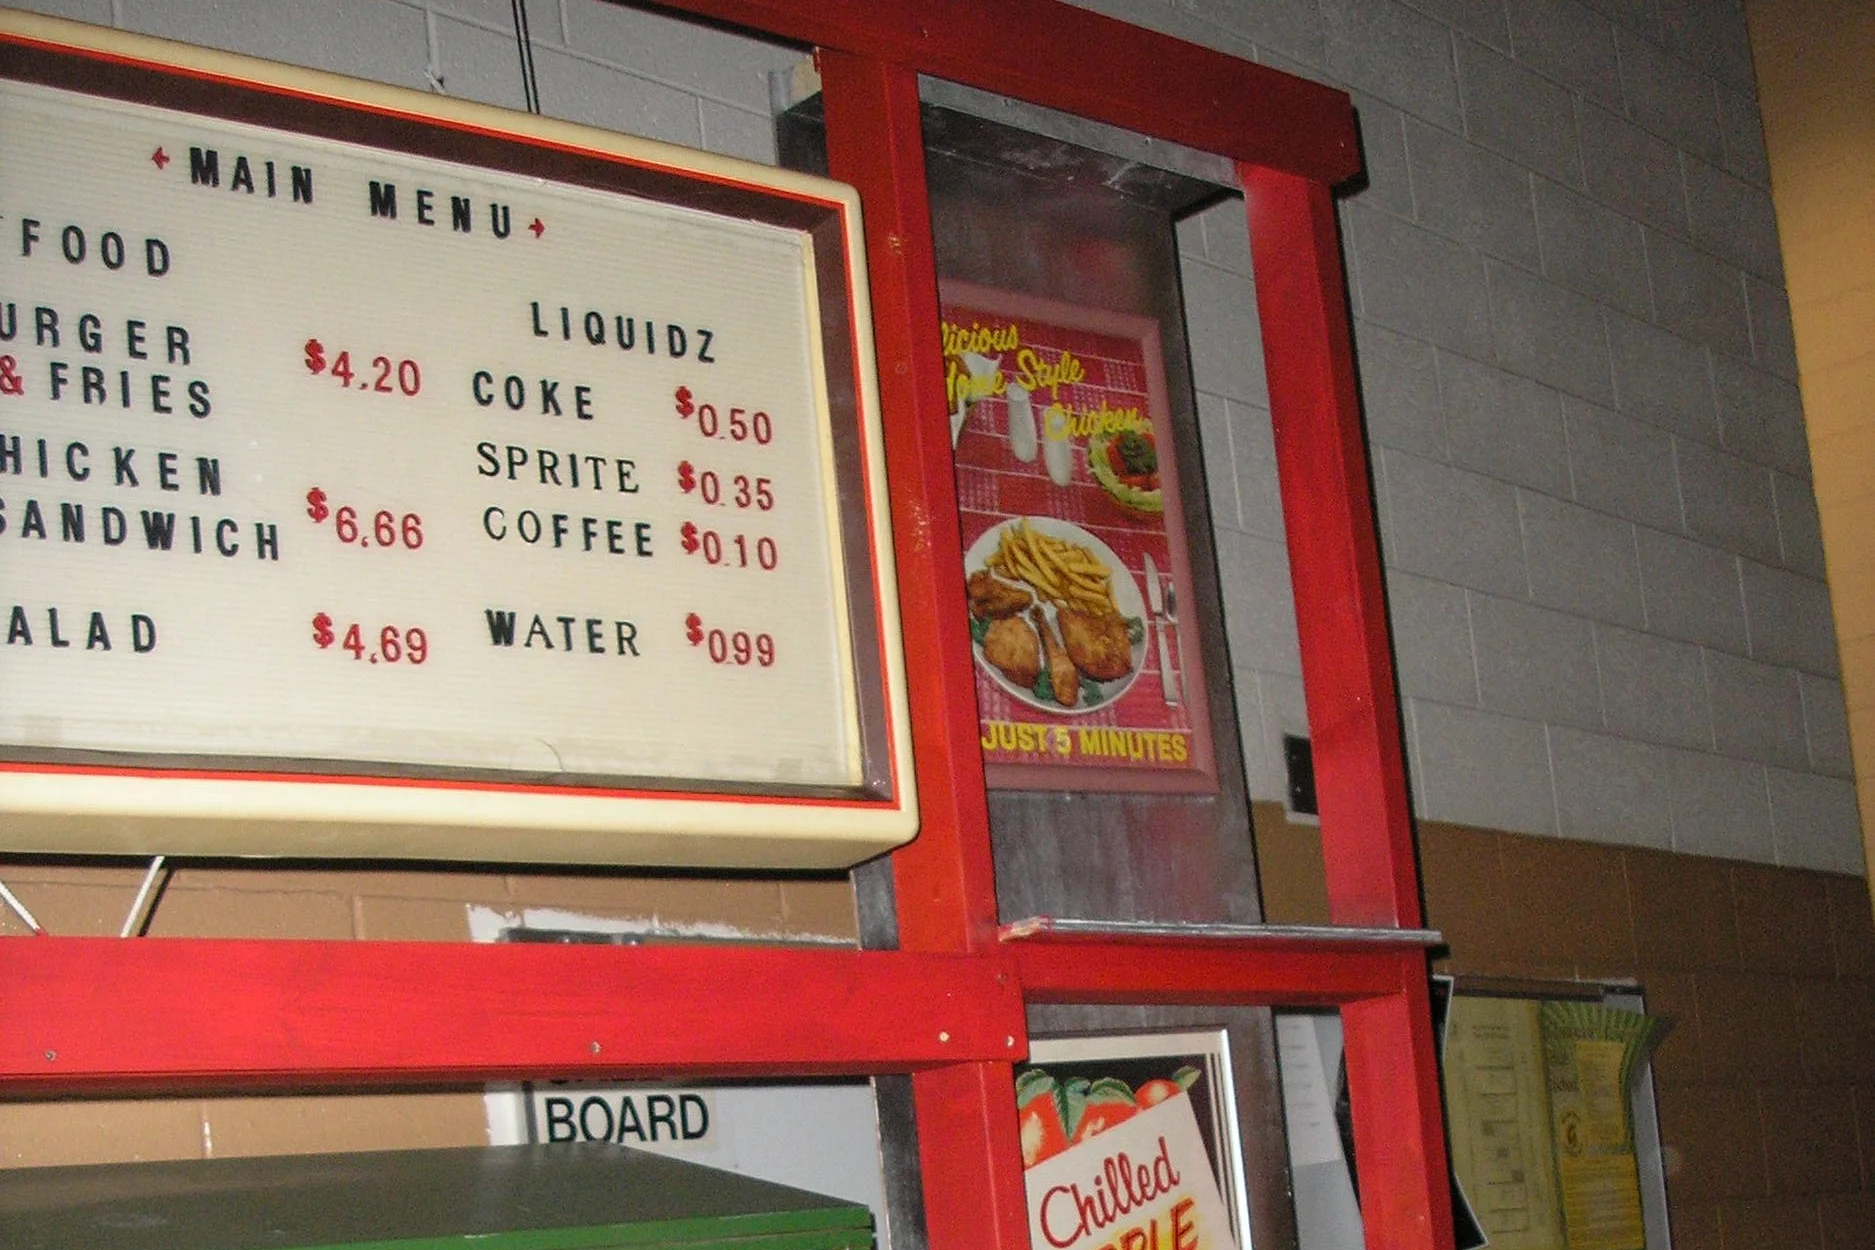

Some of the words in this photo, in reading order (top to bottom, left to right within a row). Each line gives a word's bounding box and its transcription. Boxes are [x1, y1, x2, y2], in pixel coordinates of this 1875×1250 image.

[189, 147, 314, 204] MAIN
[368, 180, 511, 239] MENU
[22, 217, 170, 277] FOOD
[0, 303, 191, 365] URGER
[530, 301, 716, 364] LIQUIDZ
[0, 355, 25, 396] &
[50, 361, 212, 419] FRIES
[1016, 348, 1085, 400] Style
[472, 370, 594, 421] COKE
[675, 386, 772, 445] $0.50
[0, 433, 222, 497] HICKEN
[476, 442, 640, 494] SPRITE
[677, 460, 775, 511] $0.35
[483, 506, 654, 558] COFFEE
[680, 520, 778, 571] $0.10
[7, 605, 157, 653] ALAD
[484, 609, 641, 657] WATER
[981, 722, 1048, 752] JUST
[1054, 725, 1072, 755] 5
[1079, 727, 1188, 763] MINUTES
[545, 1093, 710, 1144] BOARD
[1040, 1136, 1181, 1249] Chilled
